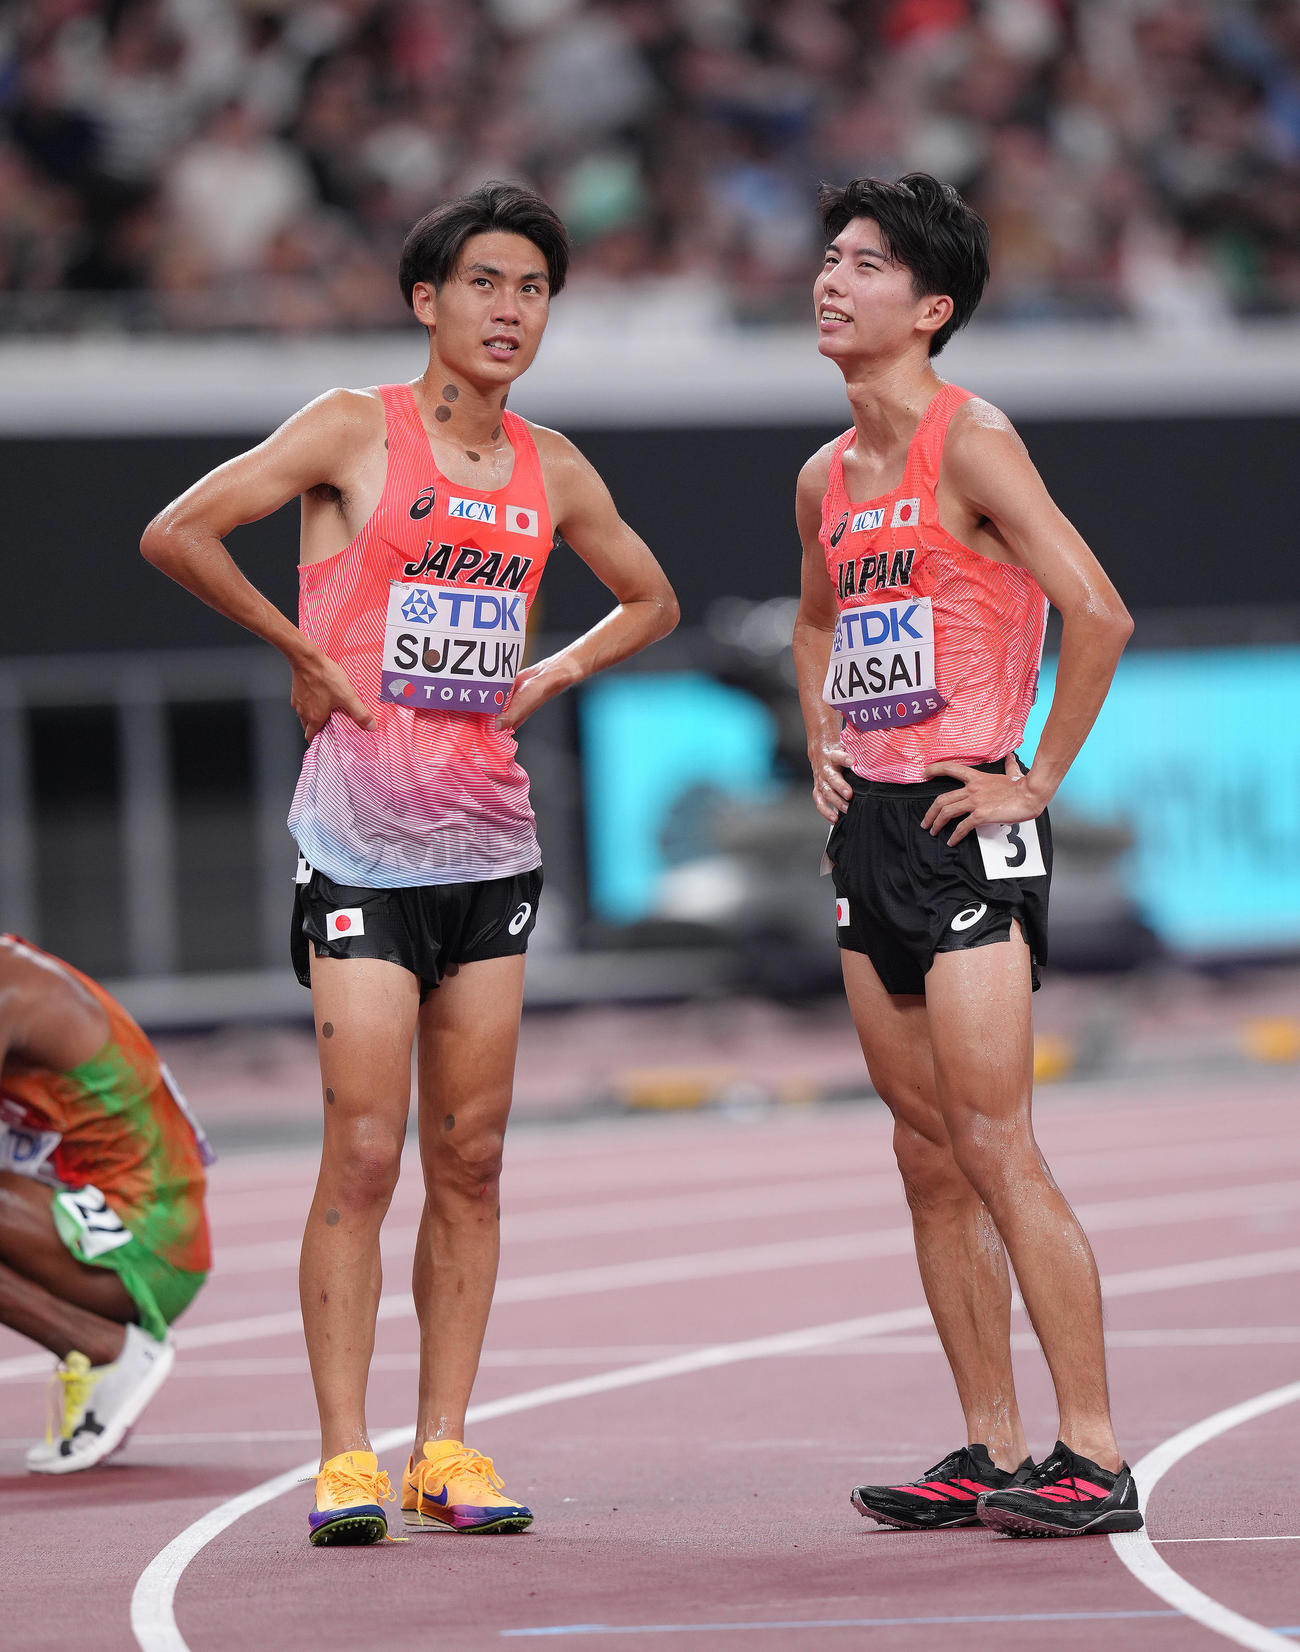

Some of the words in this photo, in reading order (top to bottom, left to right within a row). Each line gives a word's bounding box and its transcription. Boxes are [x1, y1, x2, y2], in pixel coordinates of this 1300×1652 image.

[452, 500, 495, 521] ACN
[852, 509, 884, 532] ACN
[404, 540, 533, 591] JAPAN
[837, 549, 916, 600] JAPAN
[438, 592, 520, 632] TDK
[842, 604, 924, 649] TDK
[394, 633, 520, 678] SUZUKI
[831, 651, 922, 700] KASAI
[423, 685, 511, 706] TOKYO
[1000, 822, 1026, 867] 3
